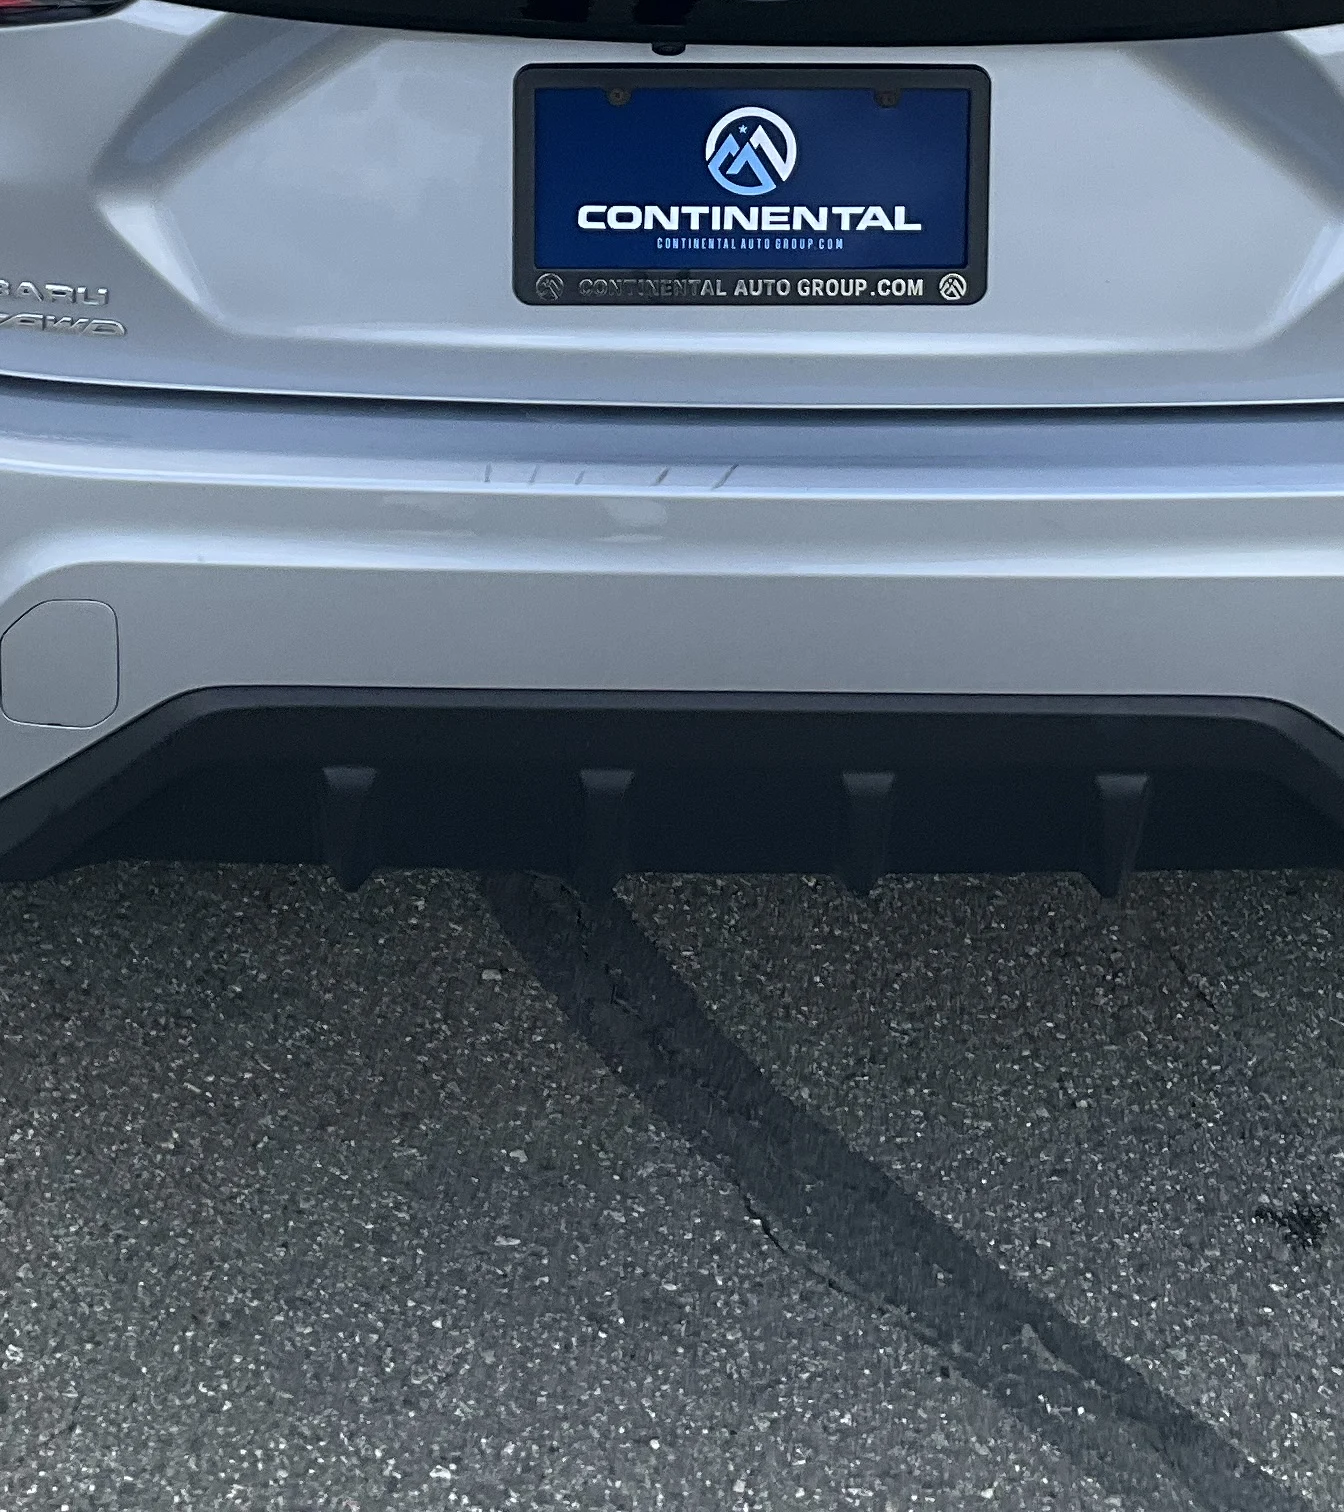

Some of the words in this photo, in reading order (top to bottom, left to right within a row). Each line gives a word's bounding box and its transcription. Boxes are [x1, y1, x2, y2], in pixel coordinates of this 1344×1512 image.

[578, 204, 922, 231] CONTINENTAL
[656, 237, 736, 250] CONTINENTAL
[740, 237, 770, 250] AUTO
[578, 278, 727, 297] CONTINENTAL
[734, 278, 791, 297] AUTO
